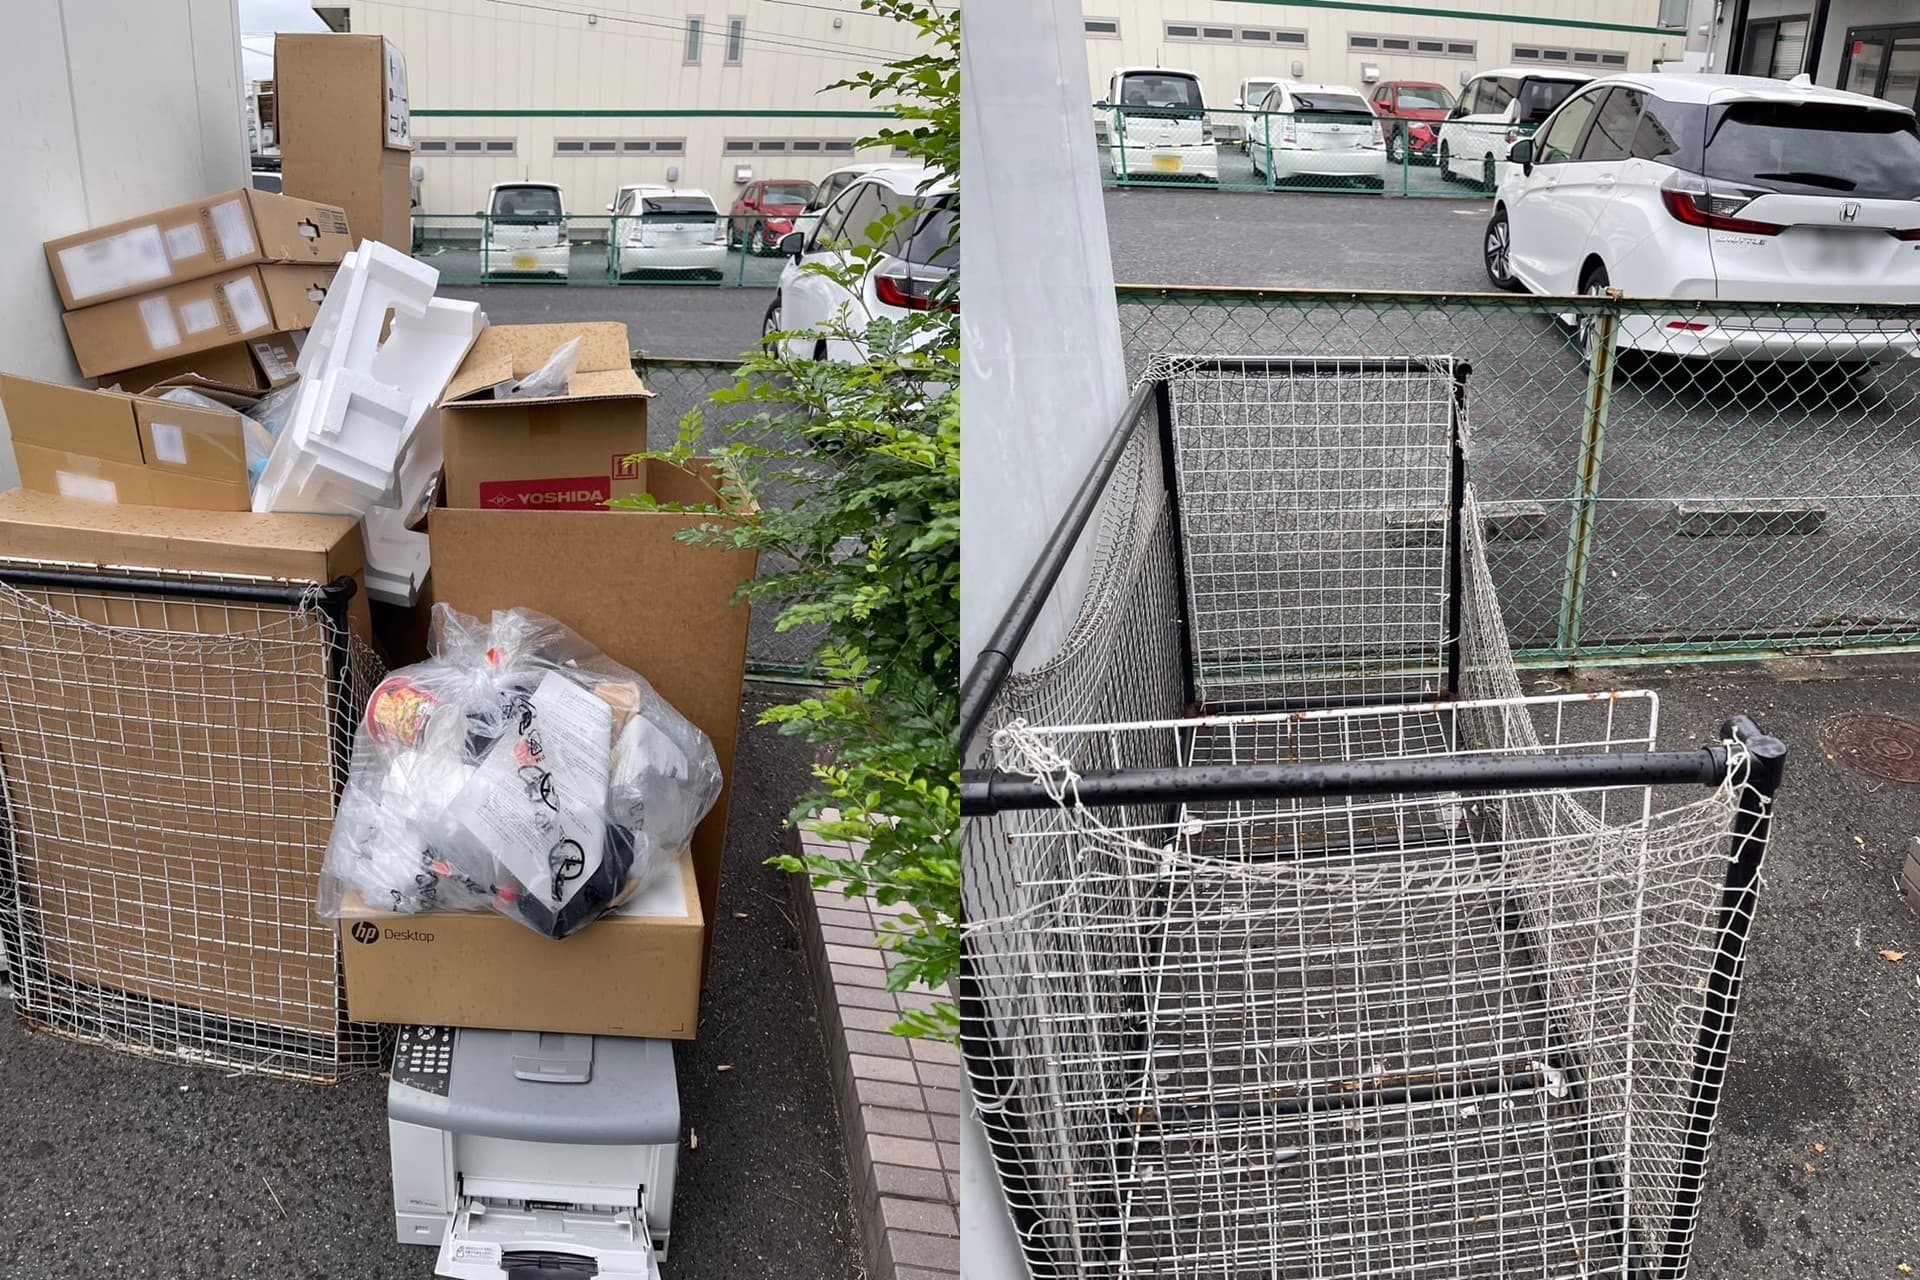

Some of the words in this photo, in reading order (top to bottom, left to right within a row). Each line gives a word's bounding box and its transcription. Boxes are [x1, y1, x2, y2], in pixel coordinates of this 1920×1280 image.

[518, 490, 604, 505] YOSHIDA
[355, 921, 378, 944] hp
[384, 928, 435, 944] Desktop
